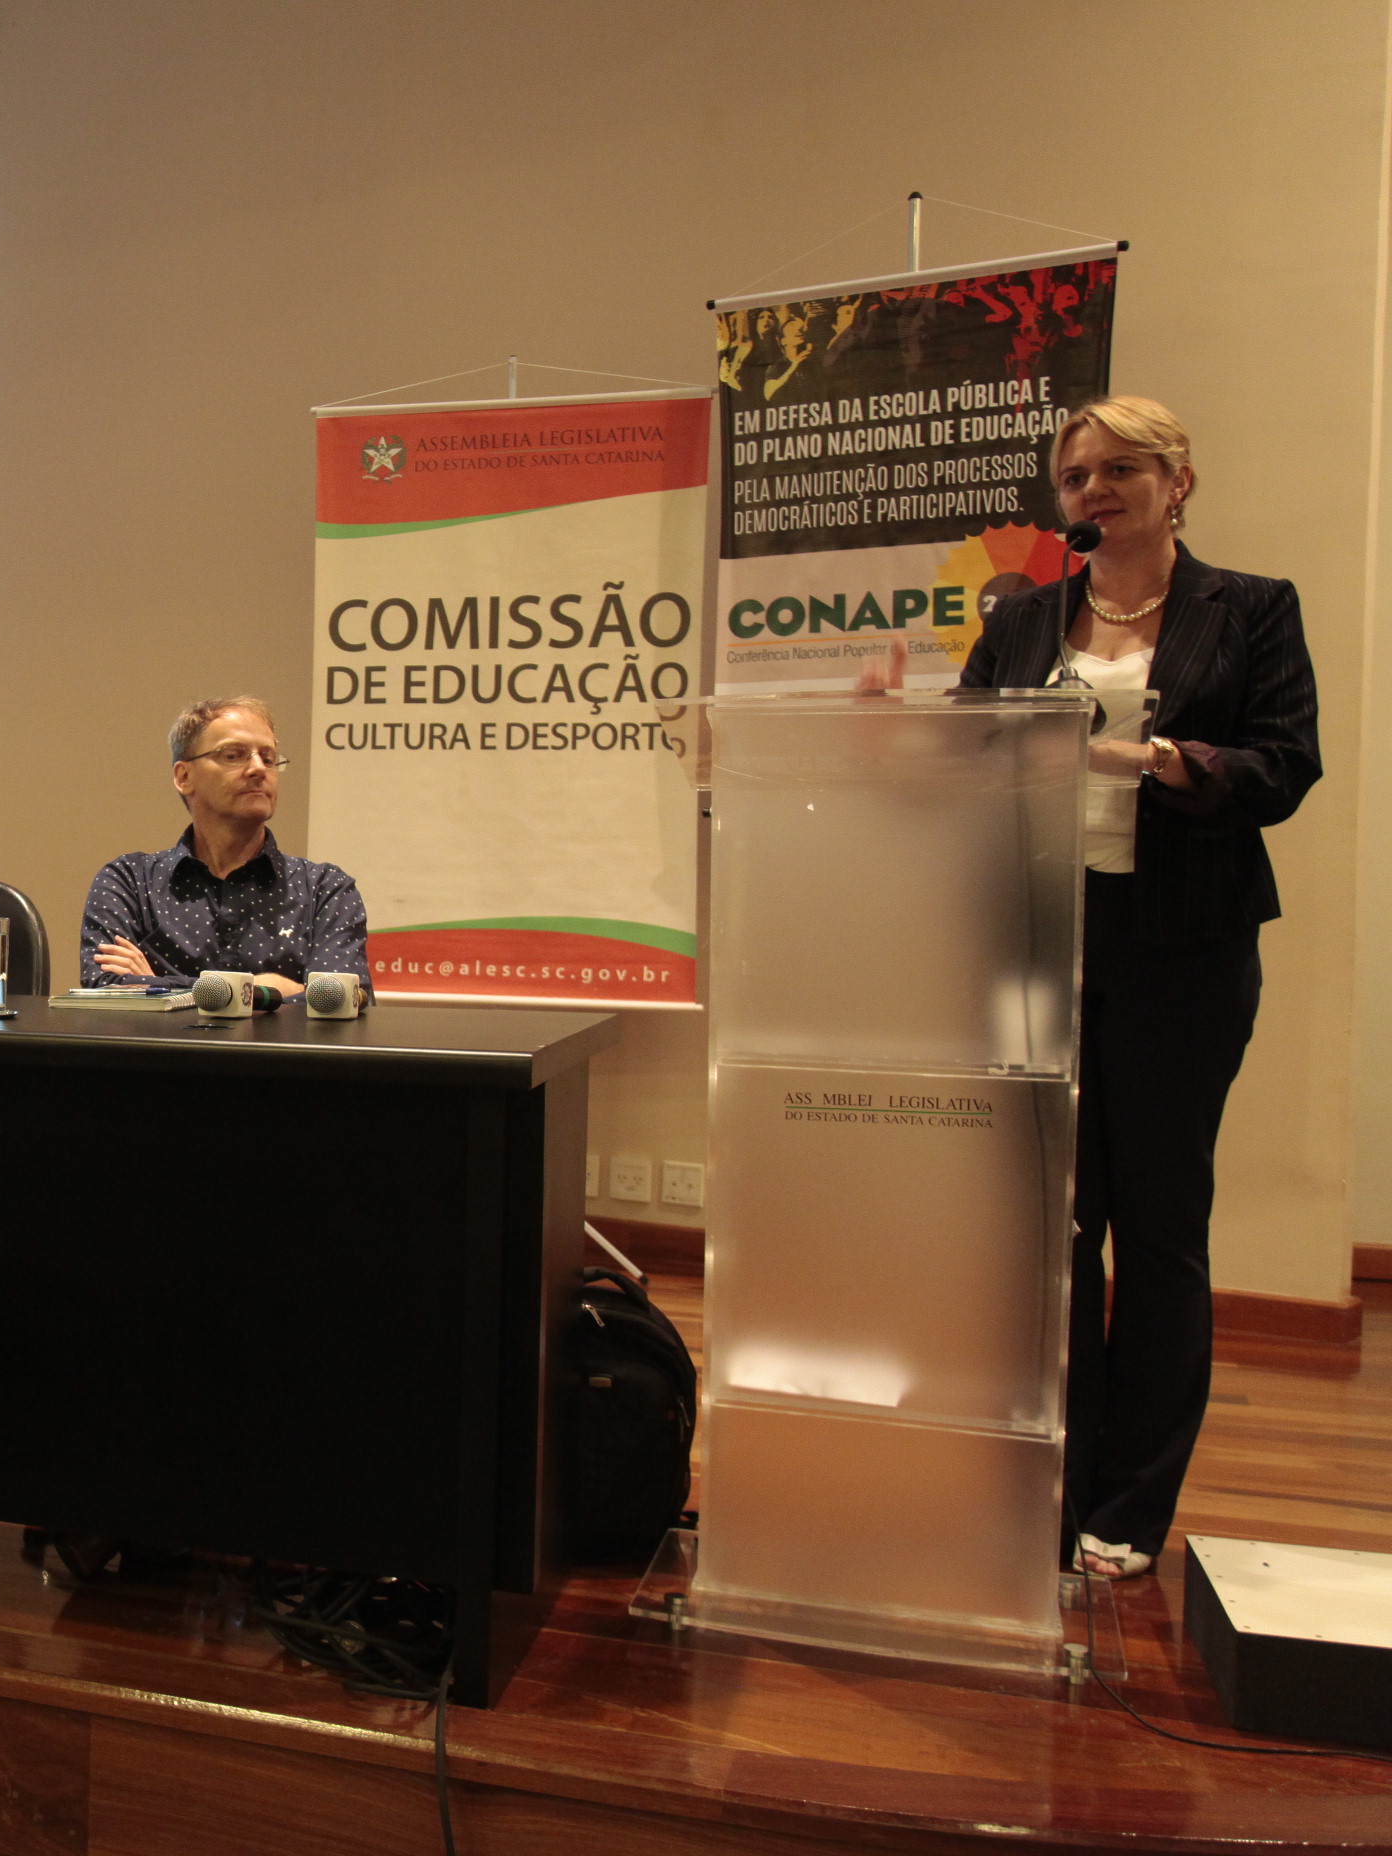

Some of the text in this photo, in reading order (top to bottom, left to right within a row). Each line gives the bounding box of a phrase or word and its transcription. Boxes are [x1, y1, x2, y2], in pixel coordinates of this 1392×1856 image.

[734, 376, 1051, 436] EM DEFESA DA ESCOLA PÚBLICA E
[414, 449, 665, 472] DO ESTADO DE SANTA CATARINA
[415, 426, 665, 453] ASSEMBLEIA LEGISLATIVA
[734, 440, 758, 466] DO
[762, 433, 823, 463] PLANO
[827, 423, 925, 456] NACIONAL
[930, 419, 956, 446] DE
[734, 452, 1038, 504] PELA MANUTENÇÃO DOS PROCESSOS
[734, 486, 1024, 535] DEMOCRÁTICOS E PARTICIPATIVOS.
[327, 581, 692, 652] COMISSÃO
[728, 585, 965, 639] CONAPE
[726, 646, 790, 664] Conferência
[792, 644, 840, 660] Nacional
[843, 642, 887, 660] Popular
[908, 638, 965, 655] Educação
[326, 653, 689, 716] DE EDUCAÇÃO
[324, 722, 471, 751] CULTURA
[480, 722, 497, 750] E
[784, 1110, 994, 1129] DO ESTADO DE SANTA CATARINA
[888, 1095, 993, 1113] LEGISLATIVA
